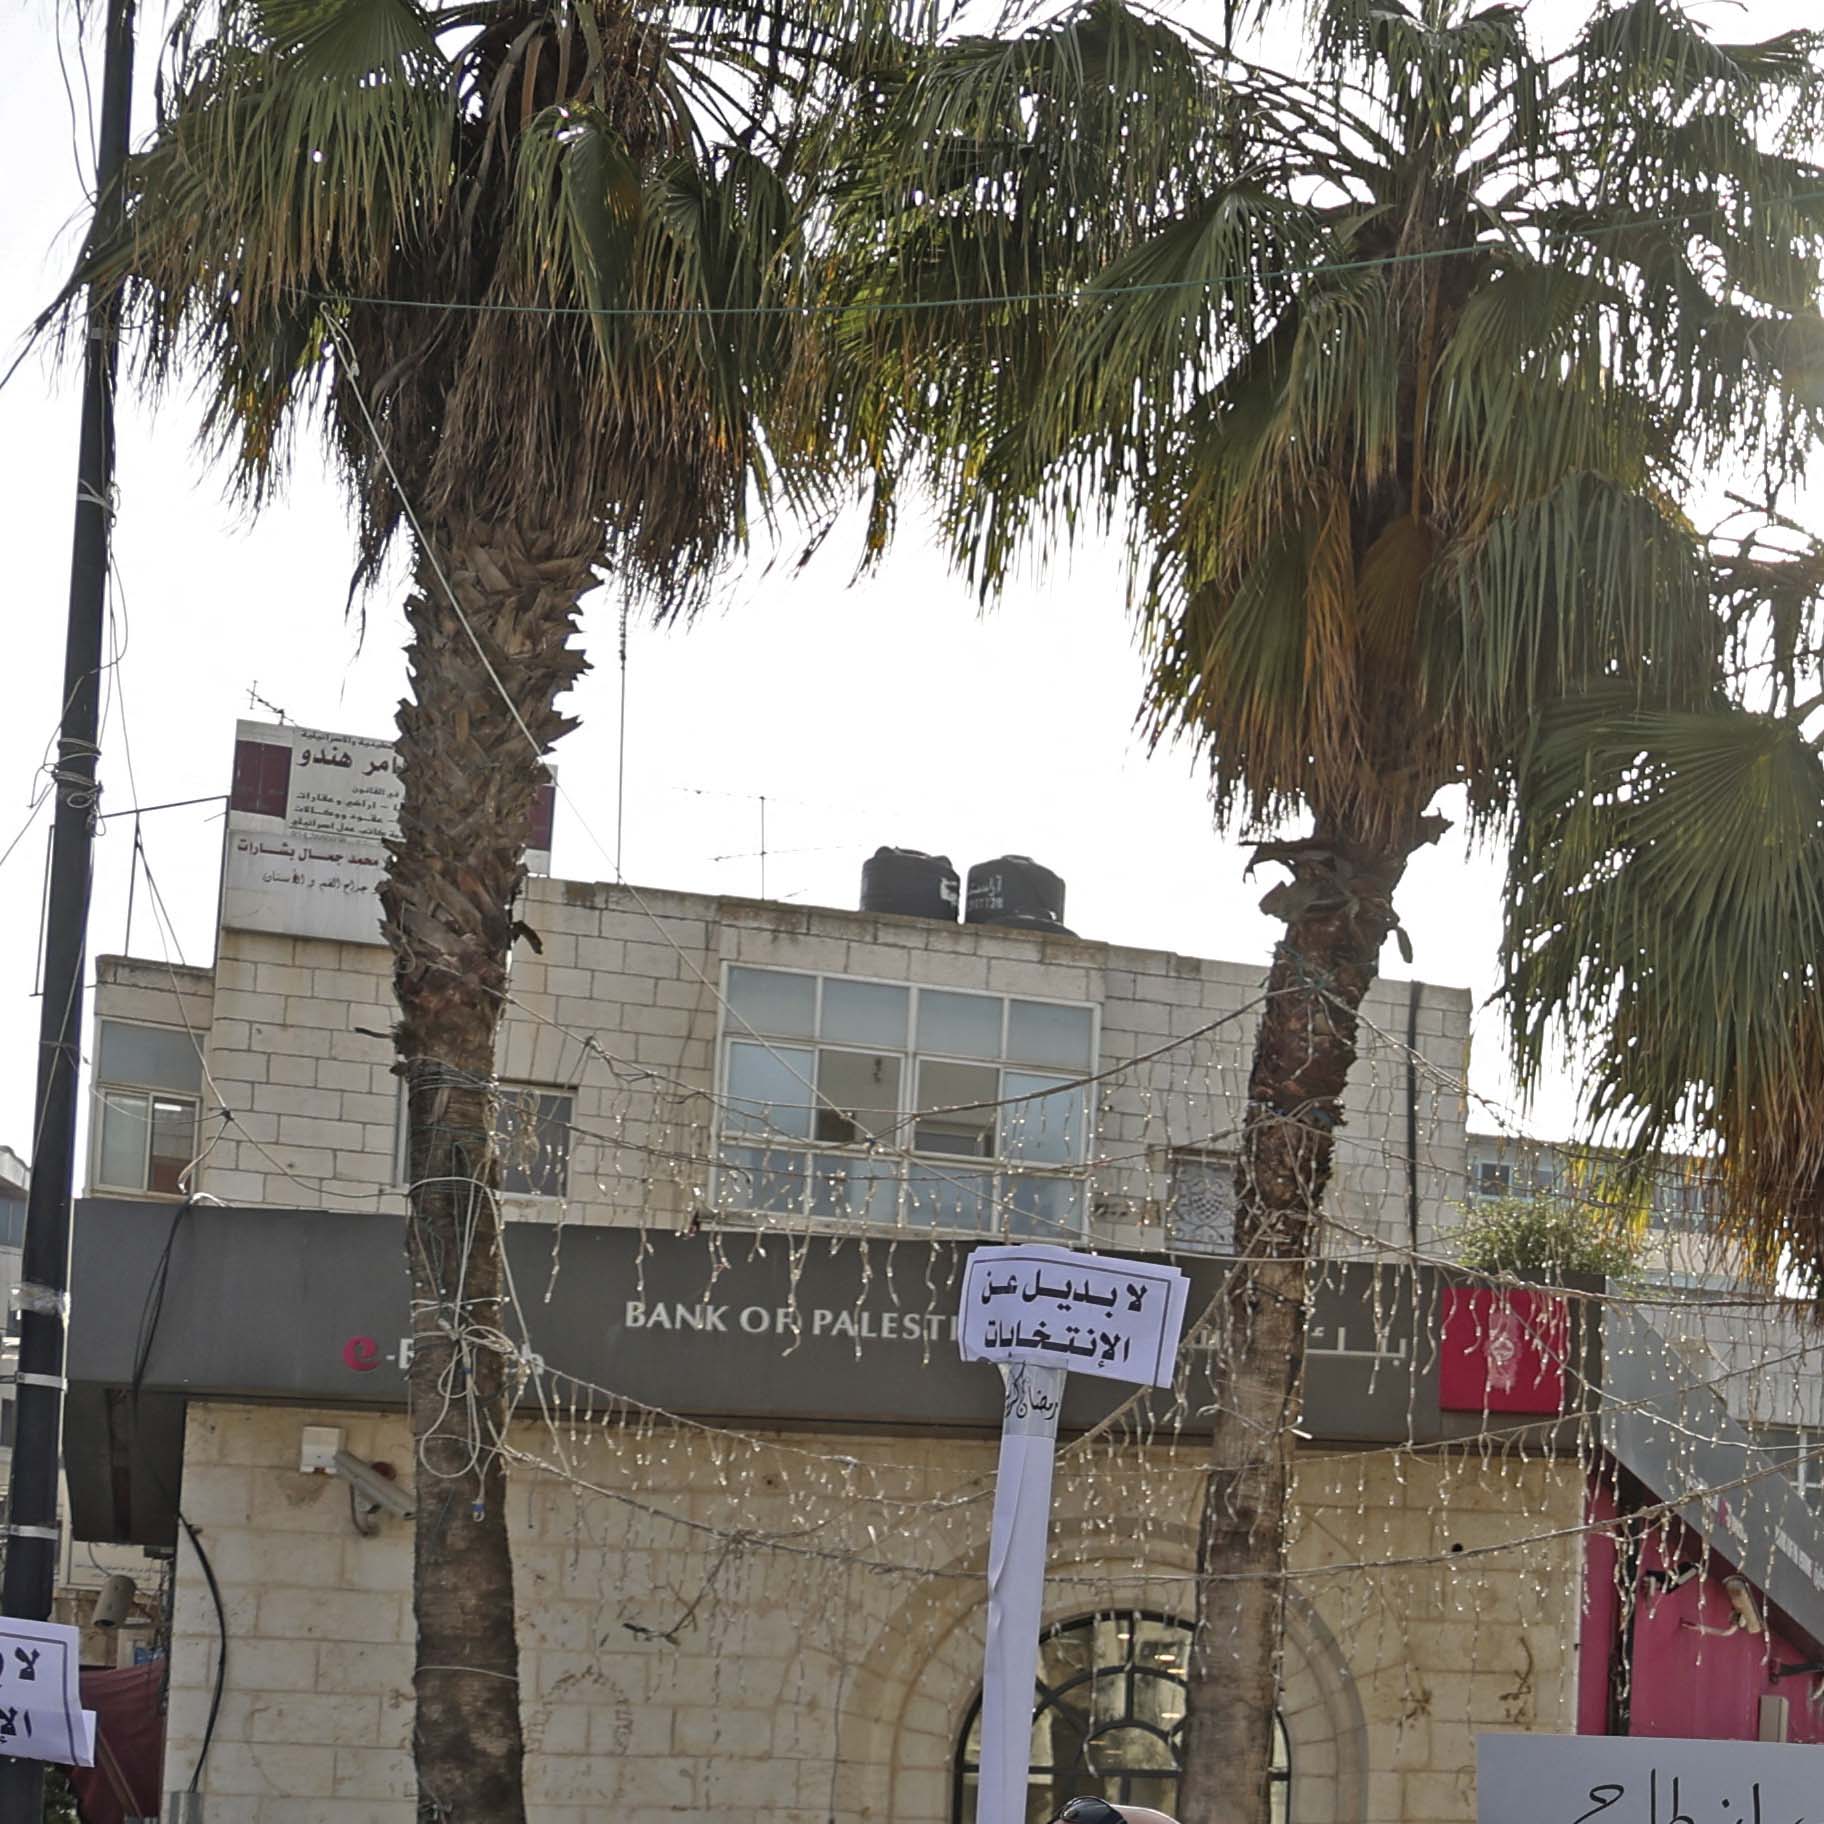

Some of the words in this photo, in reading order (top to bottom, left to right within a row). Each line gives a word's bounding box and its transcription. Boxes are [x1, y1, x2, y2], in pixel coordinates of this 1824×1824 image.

[980, 1269, 1019, 1304] عن
[1020, 1269, 1118, 1322] بديل
[1125, 1284, 1148, 1312] لا
[624, 1301, 729, 1333] BANK
[739, 1306, 800, 1335] OF
[812, 1308, 960, 1342] PALESTI
[984, 1317, 1130, 1368] الإنتخابات
